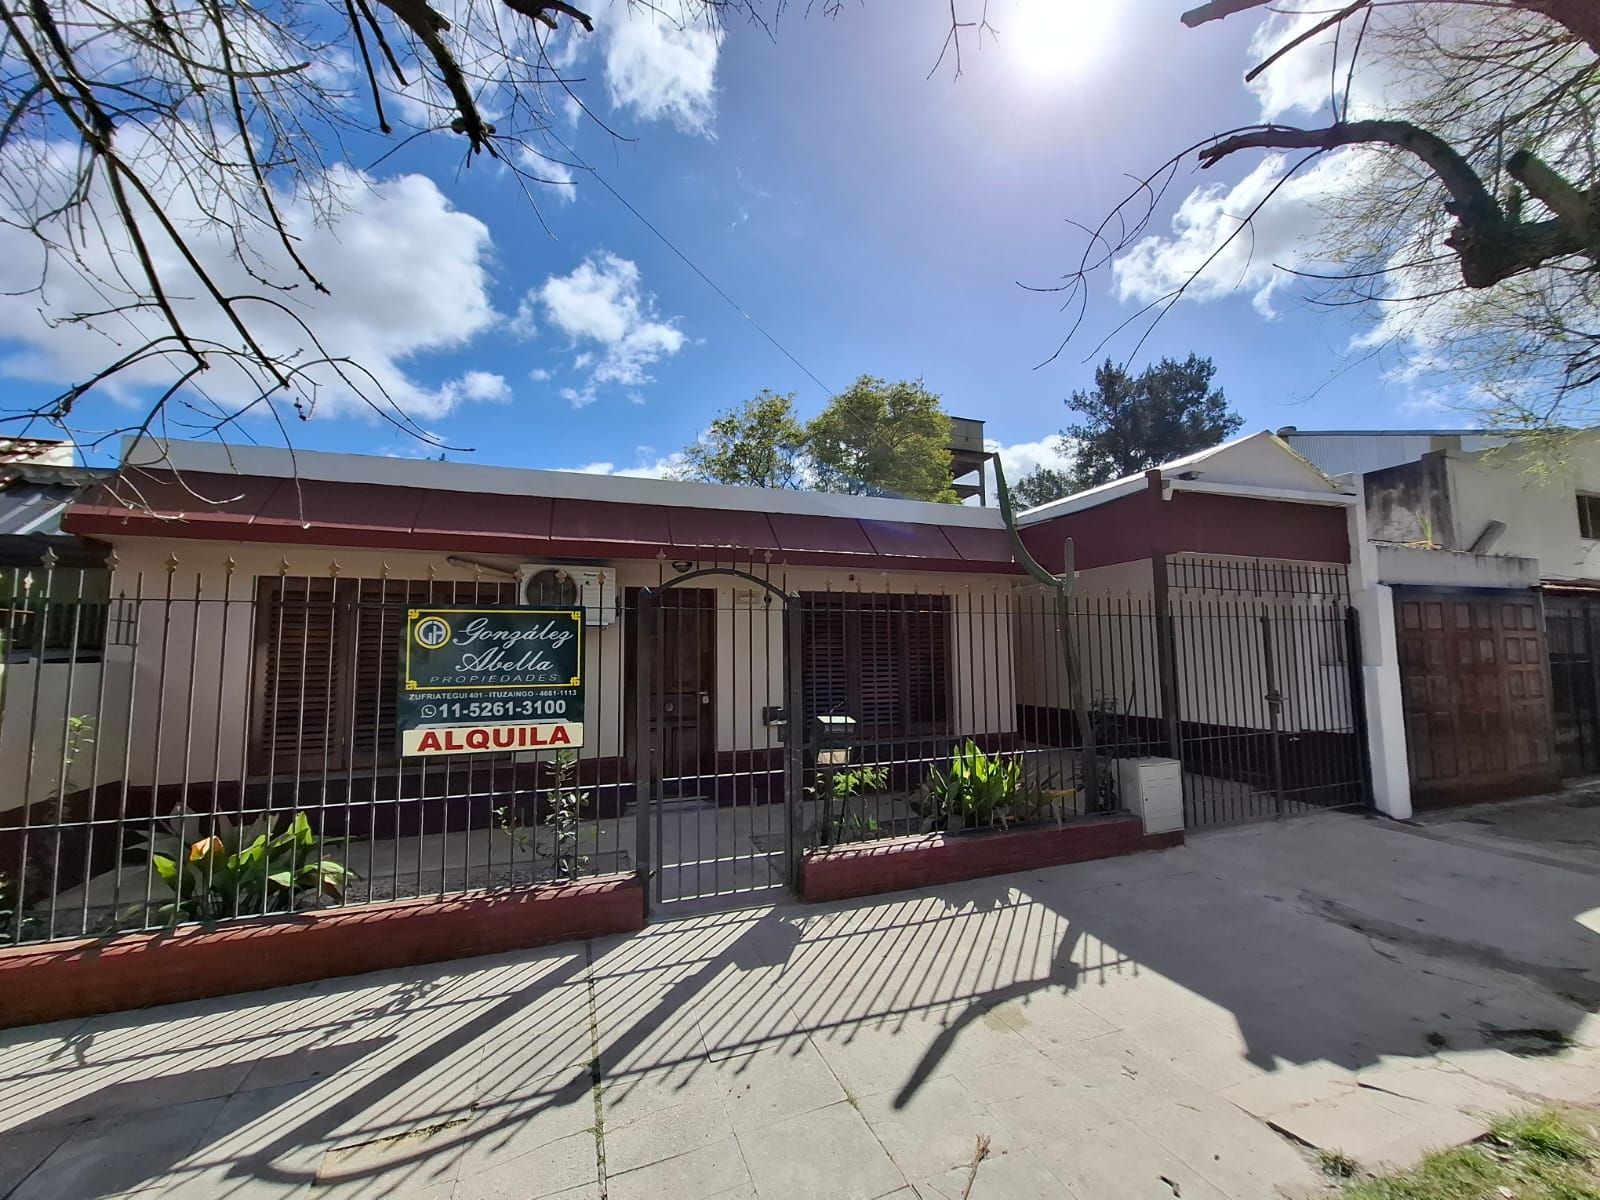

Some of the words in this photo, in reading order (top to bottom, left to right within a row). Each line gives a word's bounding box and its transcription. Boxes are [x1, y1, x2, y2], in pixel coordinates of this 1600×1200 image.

[453, 617, 575, 649] González
[455, 646, 554, 672] Abella
[430, 673, 559, 684] PROPIEDADES
[409, 692, 468, 701] ZUFRIATEGUI
[489, 690, 534, 699] ITUZAINGO
[439, 699, 567, 718] 11-5261-3100
[417, 725, 571, 752] ALQUILA
